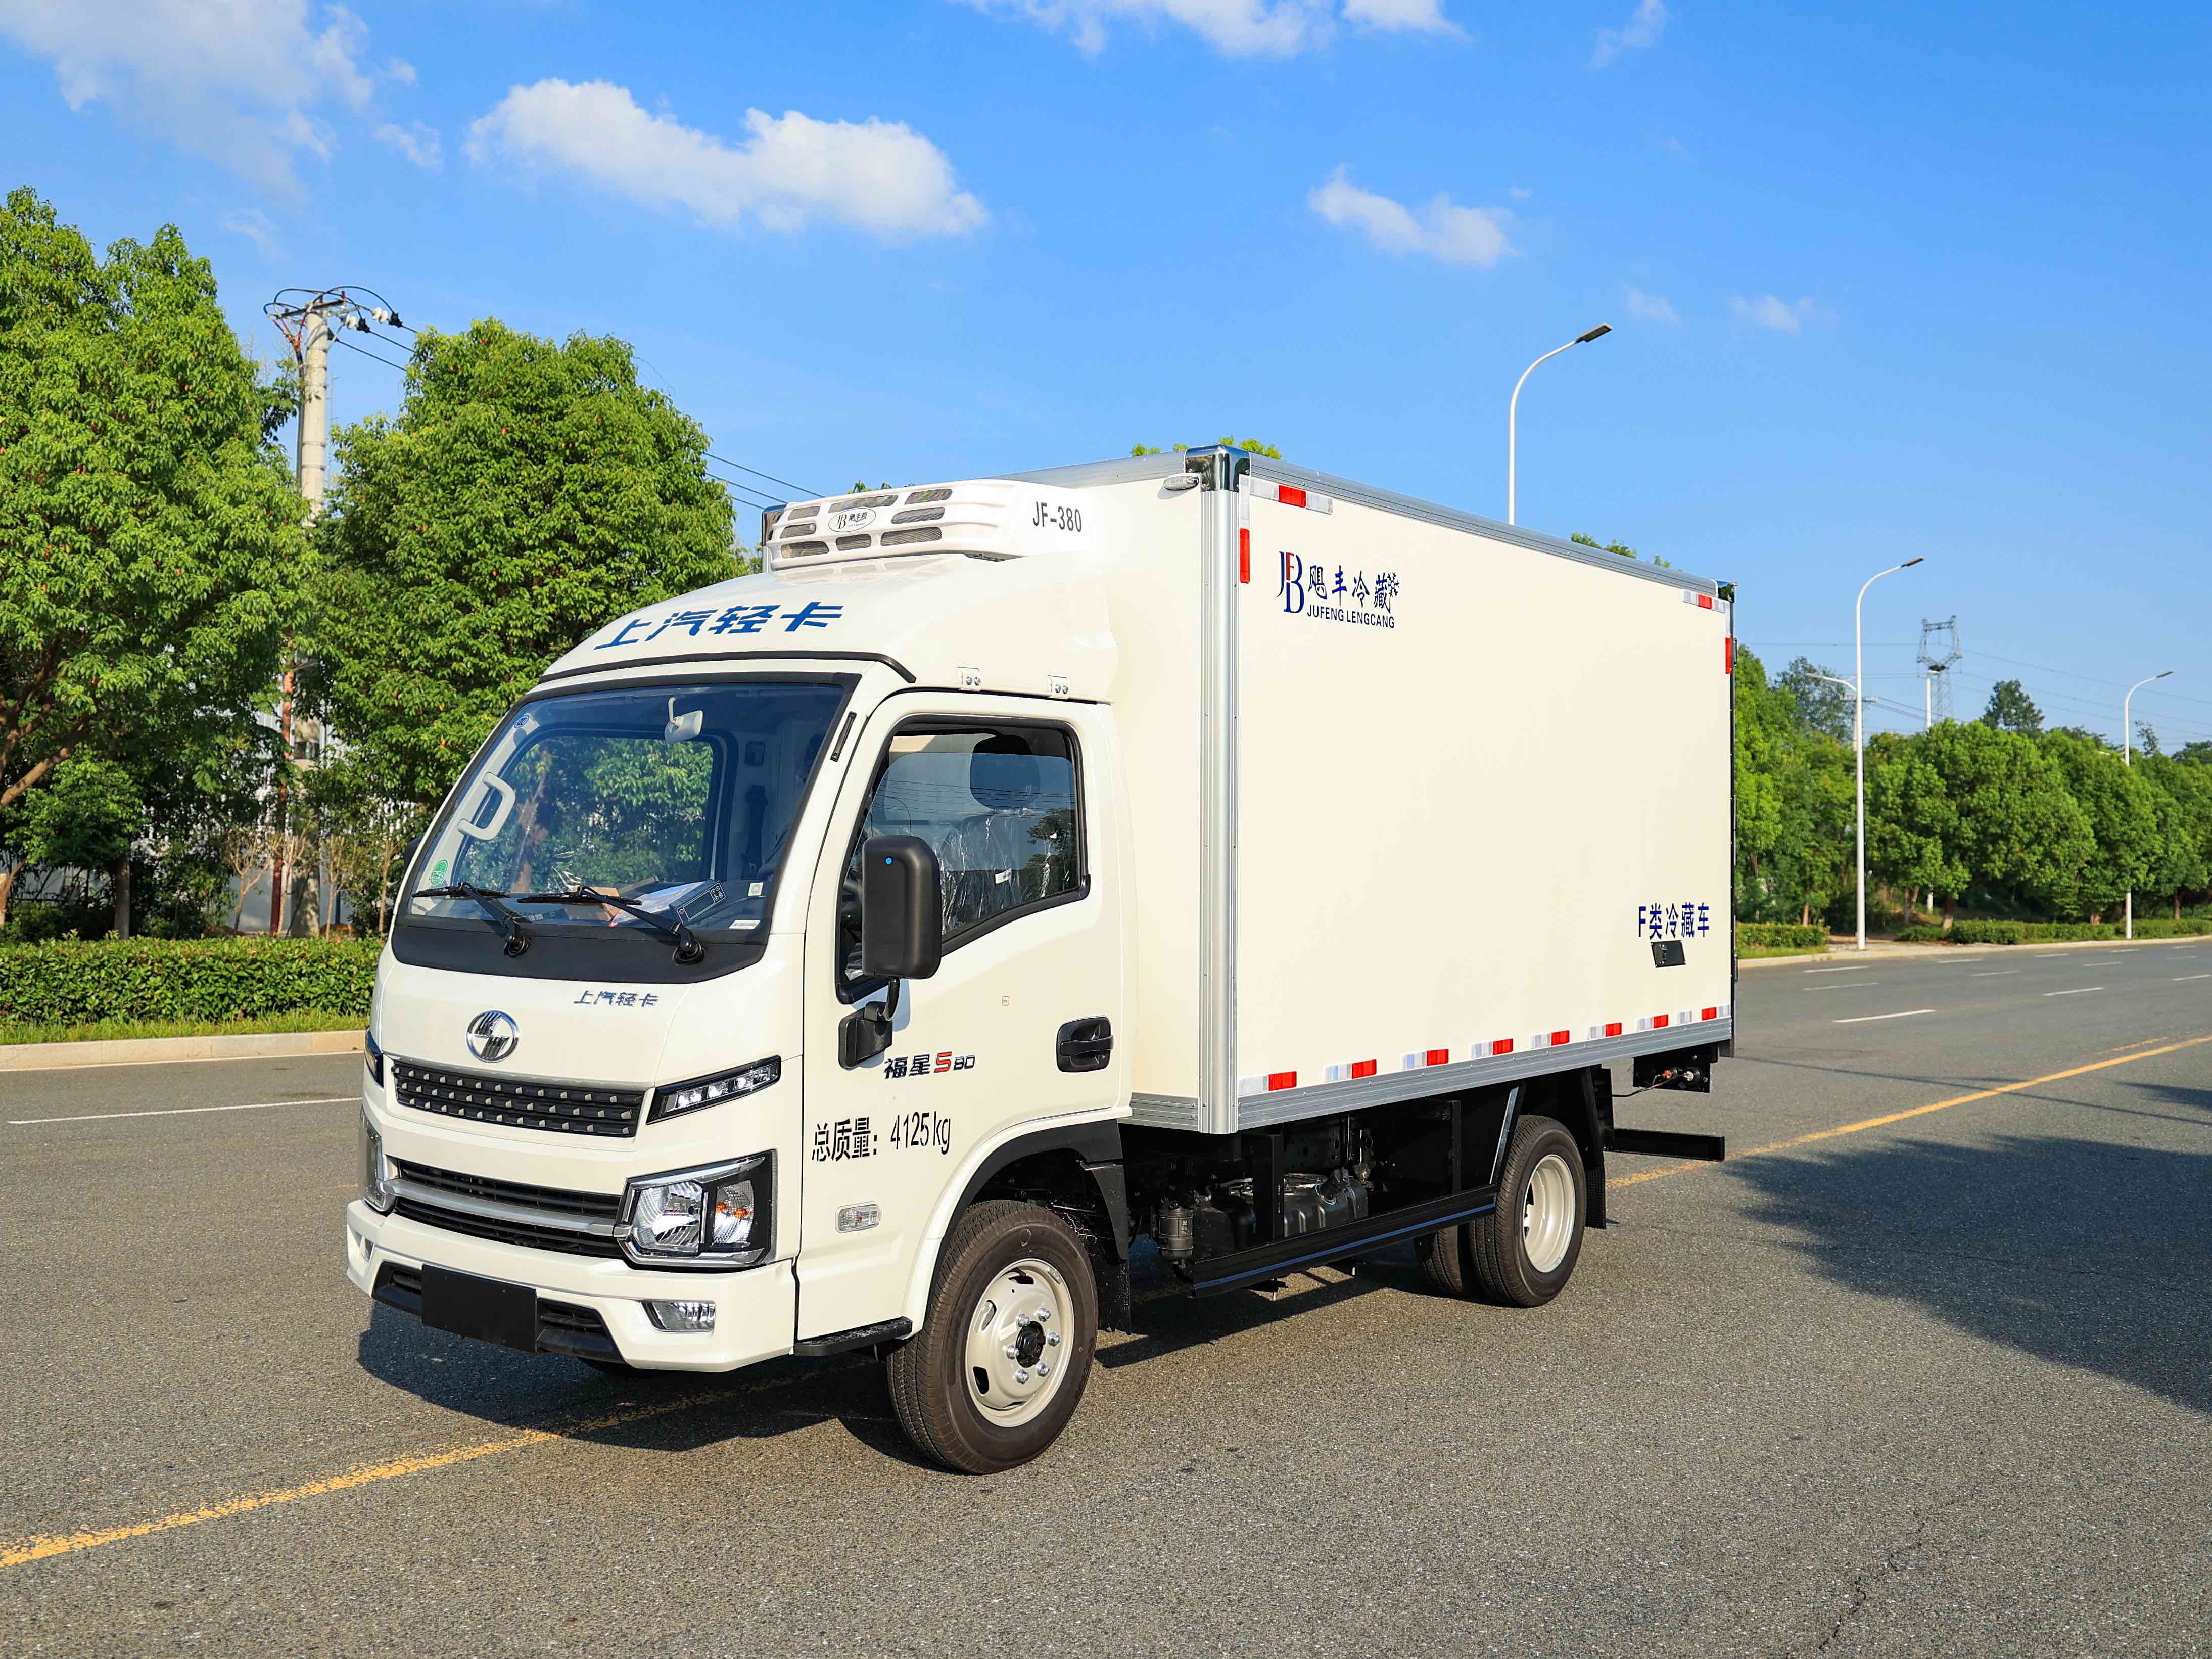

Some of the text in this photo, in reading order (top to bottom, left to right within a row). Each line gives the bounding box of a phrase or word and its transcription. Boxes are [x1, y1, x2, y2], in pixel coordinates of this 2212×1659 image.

[1032, 501, 1082, 532] JF-380
[593, 601, 844, 651] 上汽轻卡
[1307, 604, 1395, 629] JUFENG LENGCANG
[1638, 902, 1709, 940] F类冷藏车
[573, 990, 659, 1008] 上汽轻卡
